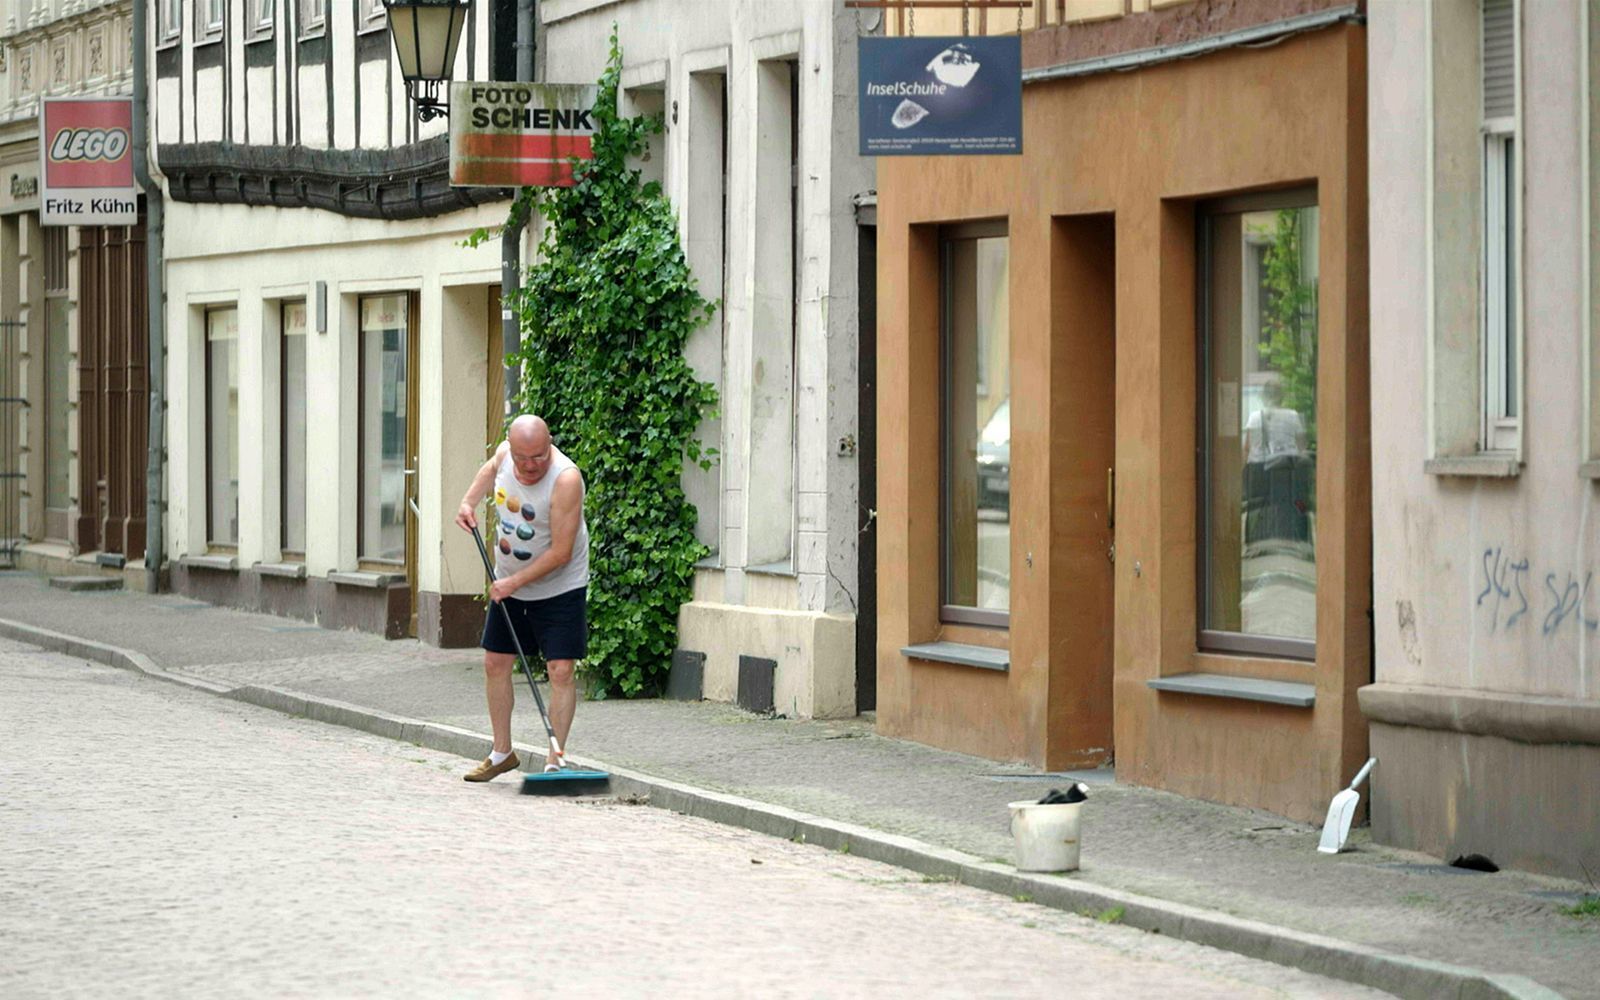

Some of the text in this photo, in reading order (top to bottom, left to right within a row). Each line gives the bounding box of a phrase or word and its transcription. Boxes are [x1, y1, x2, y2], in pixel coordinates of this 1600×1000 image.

[472, 87, 532, 104] FOTO
[866, 82, 948, 96] InselSchuhe
[471, 107, 593, 130] SCHENK
[50, 128, 128, 161] LEGO
[46, 199, 135, 214] Fritz Kühn
